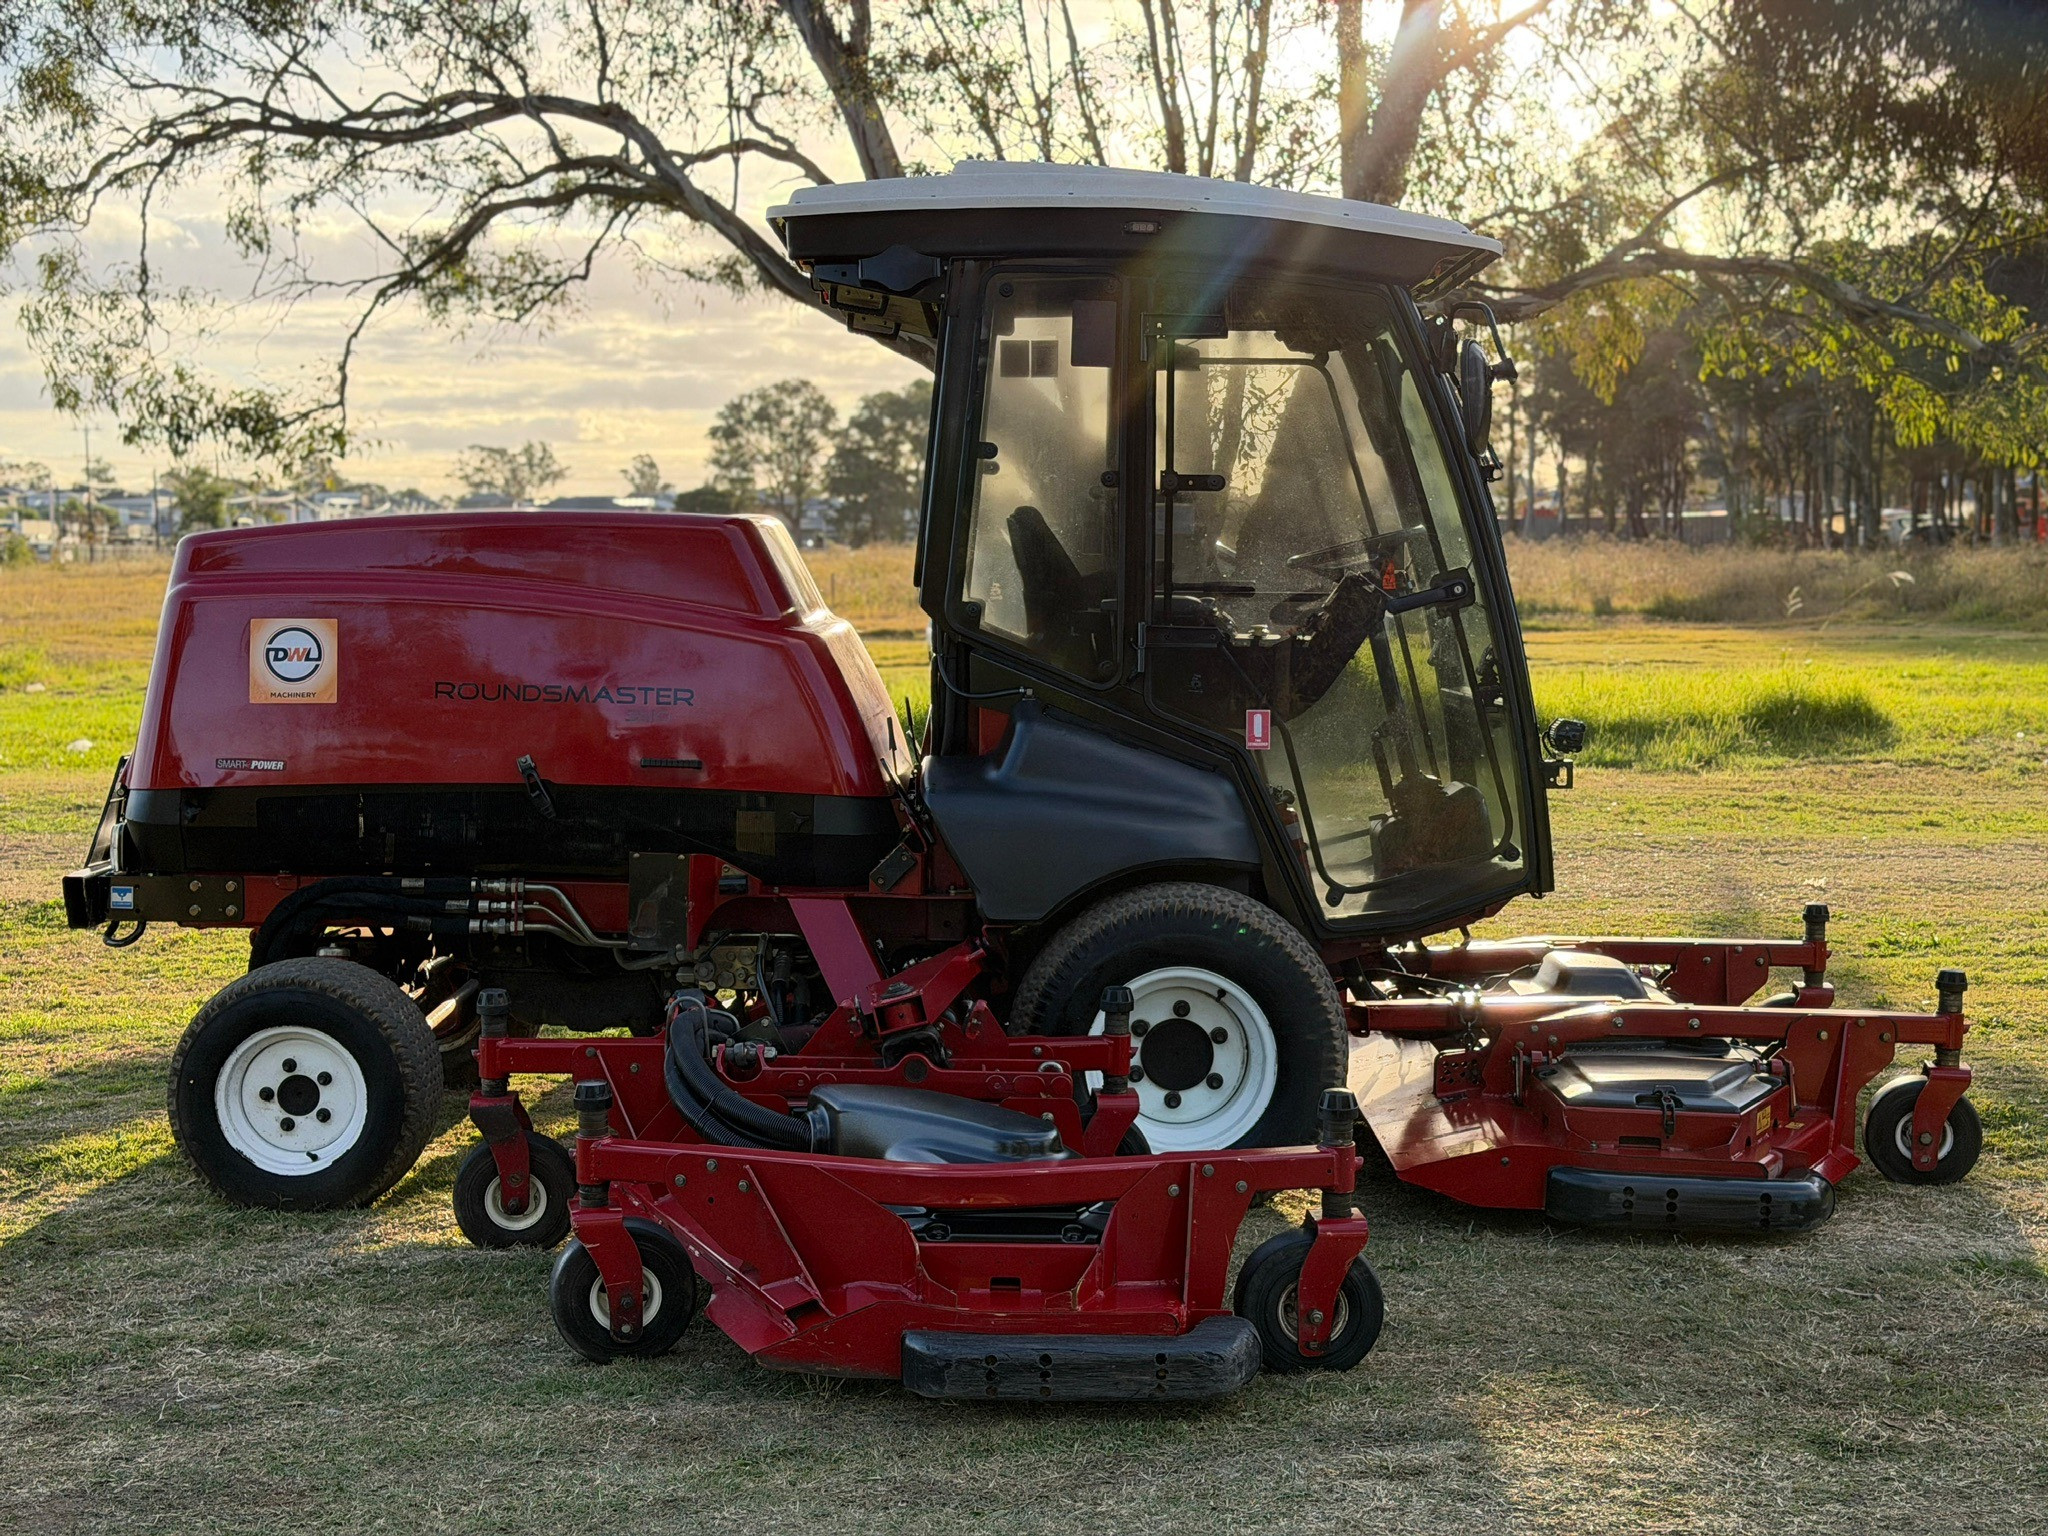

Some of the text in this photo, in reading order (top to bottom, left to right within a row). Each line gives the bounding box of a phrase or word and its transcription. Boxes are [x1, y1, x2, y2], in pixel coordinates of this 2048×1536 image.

[266, 647, 322, 662] DWL
[434, 681, 694, 706] ROUNDSMASTER
[217, 759, 284, 770] SMART POWER
